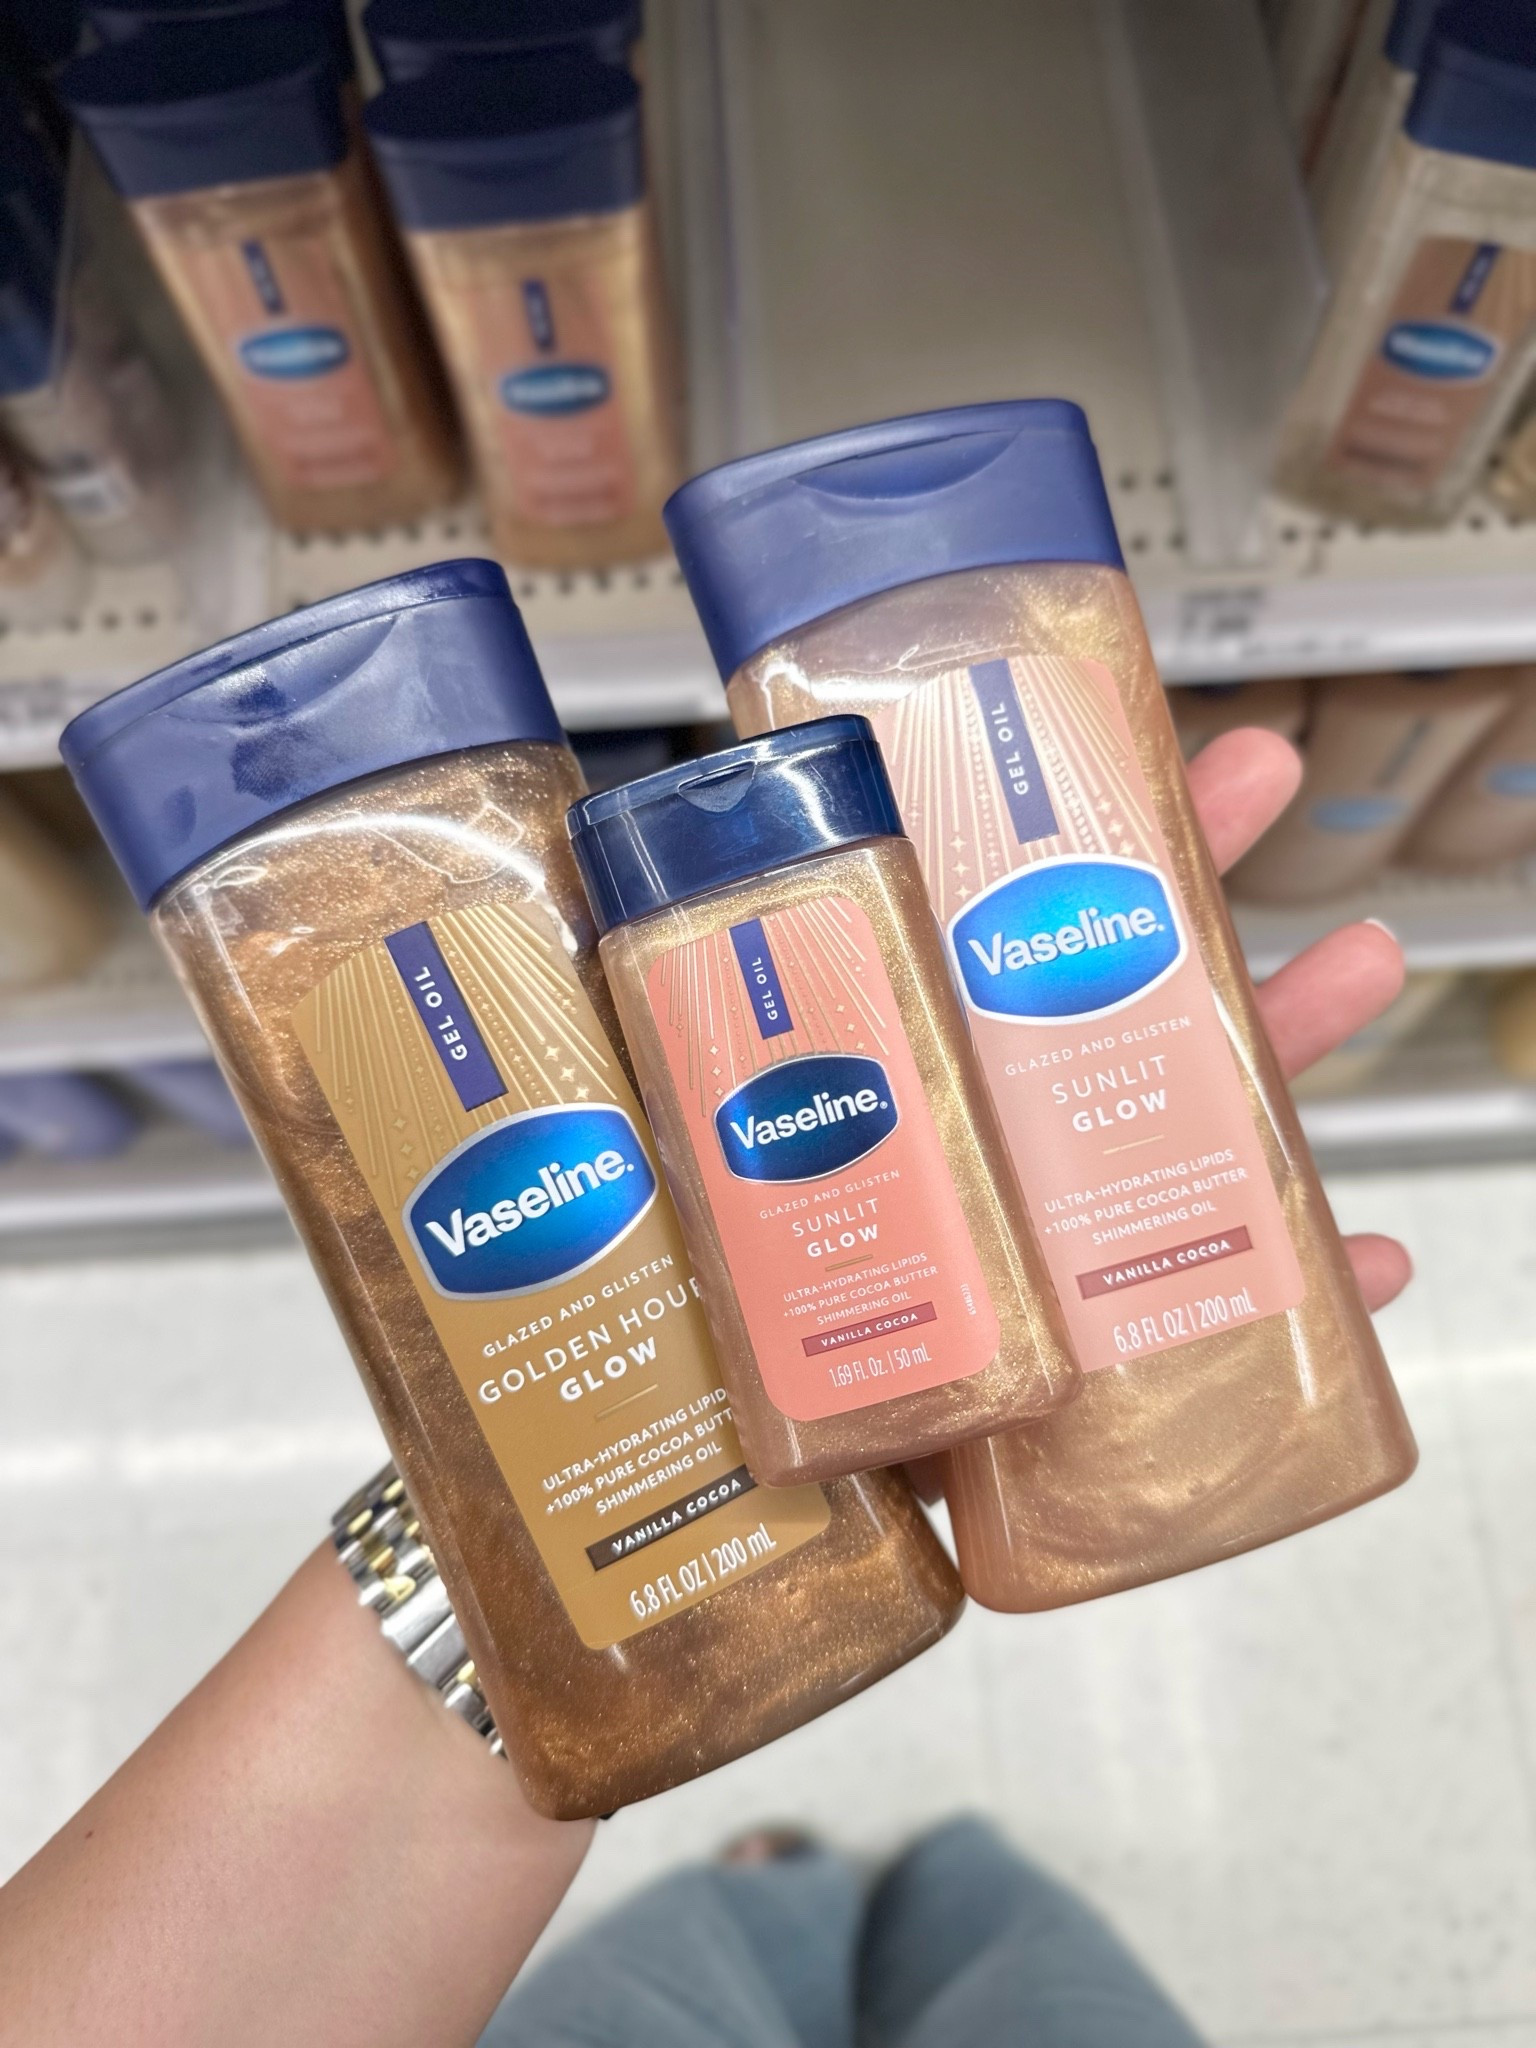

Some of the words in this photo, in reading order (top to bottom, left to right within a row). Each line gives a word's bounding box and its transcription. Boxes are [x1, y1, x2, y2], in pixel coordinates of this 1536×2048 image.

[991, 702, 1013, 743] OIL
[1006, 752, 1030, 796] GEL
[414, 966, 443, 1008] OIL
[752, 957, 767, 985] OIL
[762, 990, 779, 1020] GEL
[438, 1015, 468, 1061] GEL
[1005, 1048, 1073, 1078] GLAZED
[1081, 1037, 1116, 1056] AND
[1121, 1016, 1192, 1044] GLISTEN
[1052, 1055, 1168, 1105] SUNLIT
[1072, 1089, 1167, 1133] GLOW
[759, 1197, 809, 1220] GLAZED
[813, 1188, 841, 1203] AND
[844, 1169, 900, 1193] GLISTEN
[1044, 1163, 1188, 1214] ULTRA-HYDRATING
[1190, 1149, 1235, 1171] LIPIDS
[1044, 1213, 1092, 1235] +100%
[1094, 1200, 1134, 1222] PURE
[1136, 1185, 1190, 1211] COCOA
[1193, 1167, 1248, 1193] BUTTER
[792, 1198, 880, 1237] SUNLIT
[807, 1224, 879, 1257] GLOW
[1092, 1207, 1188, 1245] SHIMMERING
[1192, 1199, 1217, 1216] OIL
[783, 1264, 890, 1303] ULTRA-HYDRATING
[892, 1253, 927, 1270] LIPIDS
[1103, 1256, 1173, 1286] VANILLA
[1176, 1239, 1231, 1264] COCOA
[482, 1315, 552, 1358] GLAZED
[559, 1294, 596, 1321] AND
[601, 1254, 673, 1298] GLISTEN
[783, 1302, 817, 1318] +100%
[818, 1293, 848, 1310] PURE
[849, 1281, 891, 1300] COCOA
[893, 1265, 938, 1286] BUTTER
[816, 1297, 890, 1326] SHIMMERING
[892, 1291, 912, 1304] OIL
[821, 1326, 872, 1348] VANILLA
[876, 1313, 919, 1331] COCOA
[1113, 1321, 1141, 1353] 6.8
[1141, 1315, 1163, 1346] FL
[1162, 1306, 1188, 1337] OZ
[1195, 1294, 1229, 1325] 200
[1229, 1287, 1258, 1315] mL
[478, 1324, 612, 1404] GOLDEN
[559, 1337, 658, 1402] GLOW
[829, 1364, 853, 1388] 1.69
[893, 1347, 911, 1370] 50
[910, 1342, 932, 1365] mL
[542, 1408, 688, 1492] ULTRA-HYDRATING
[690, 1387, 727, 1416] LIPID
[545, 1483, 594, 1515] +100%
[595, 1461, 636, 1489] PURE
[638, 1432, 694, 1469] COCOA
[694, 1407, 733, 1438] BUTT
[595, 1455, 694, 1515] SHIMMERING
[696, 1441, 722, 1462] OIL
[612, 1510, 683, 1554] VANILLA
[686, 1478, 742, 1515] COCOA
[630, 1583, 660, 1618] 6.8
[659, 1574, 683, 1606] FL
[678, 1559, 707, 1593] OZ
[711, 1536, 748, 1576] 200
[747, 1522, 777, 1560] mL
